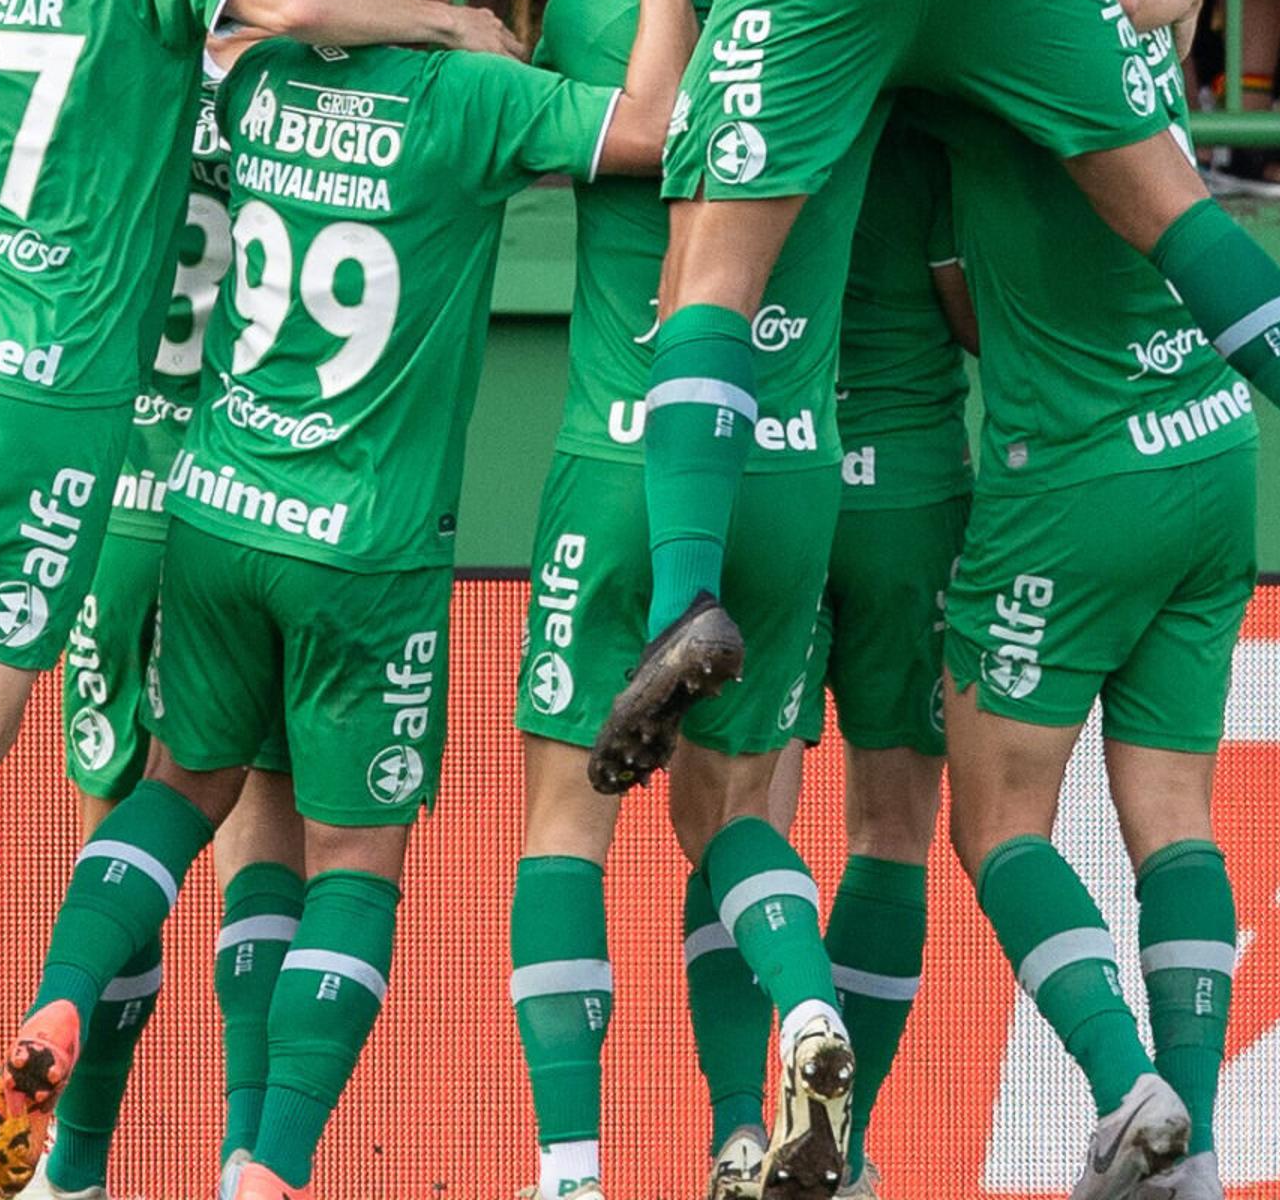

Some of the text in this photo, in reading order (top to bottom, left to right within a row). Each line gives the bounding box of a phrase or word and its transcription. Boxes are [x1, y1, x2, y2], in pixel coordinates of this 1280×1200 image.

[316, 92, 375, 119] GRUPO
[708, 9, 771, 117] alfa
[235, 153, 392, 212] CARVALHEIRA
[275, 110, 402, 168] BUGIO
[230, 200, 401, 399] 99
[1126, 380, 1253, 456] Unime
[21, 467, 96, 588] alfa
[167, 449, 348, 544] Unimed
[538, 534, 586, 648] alfa
[382, 630, 437, 738] alfa
